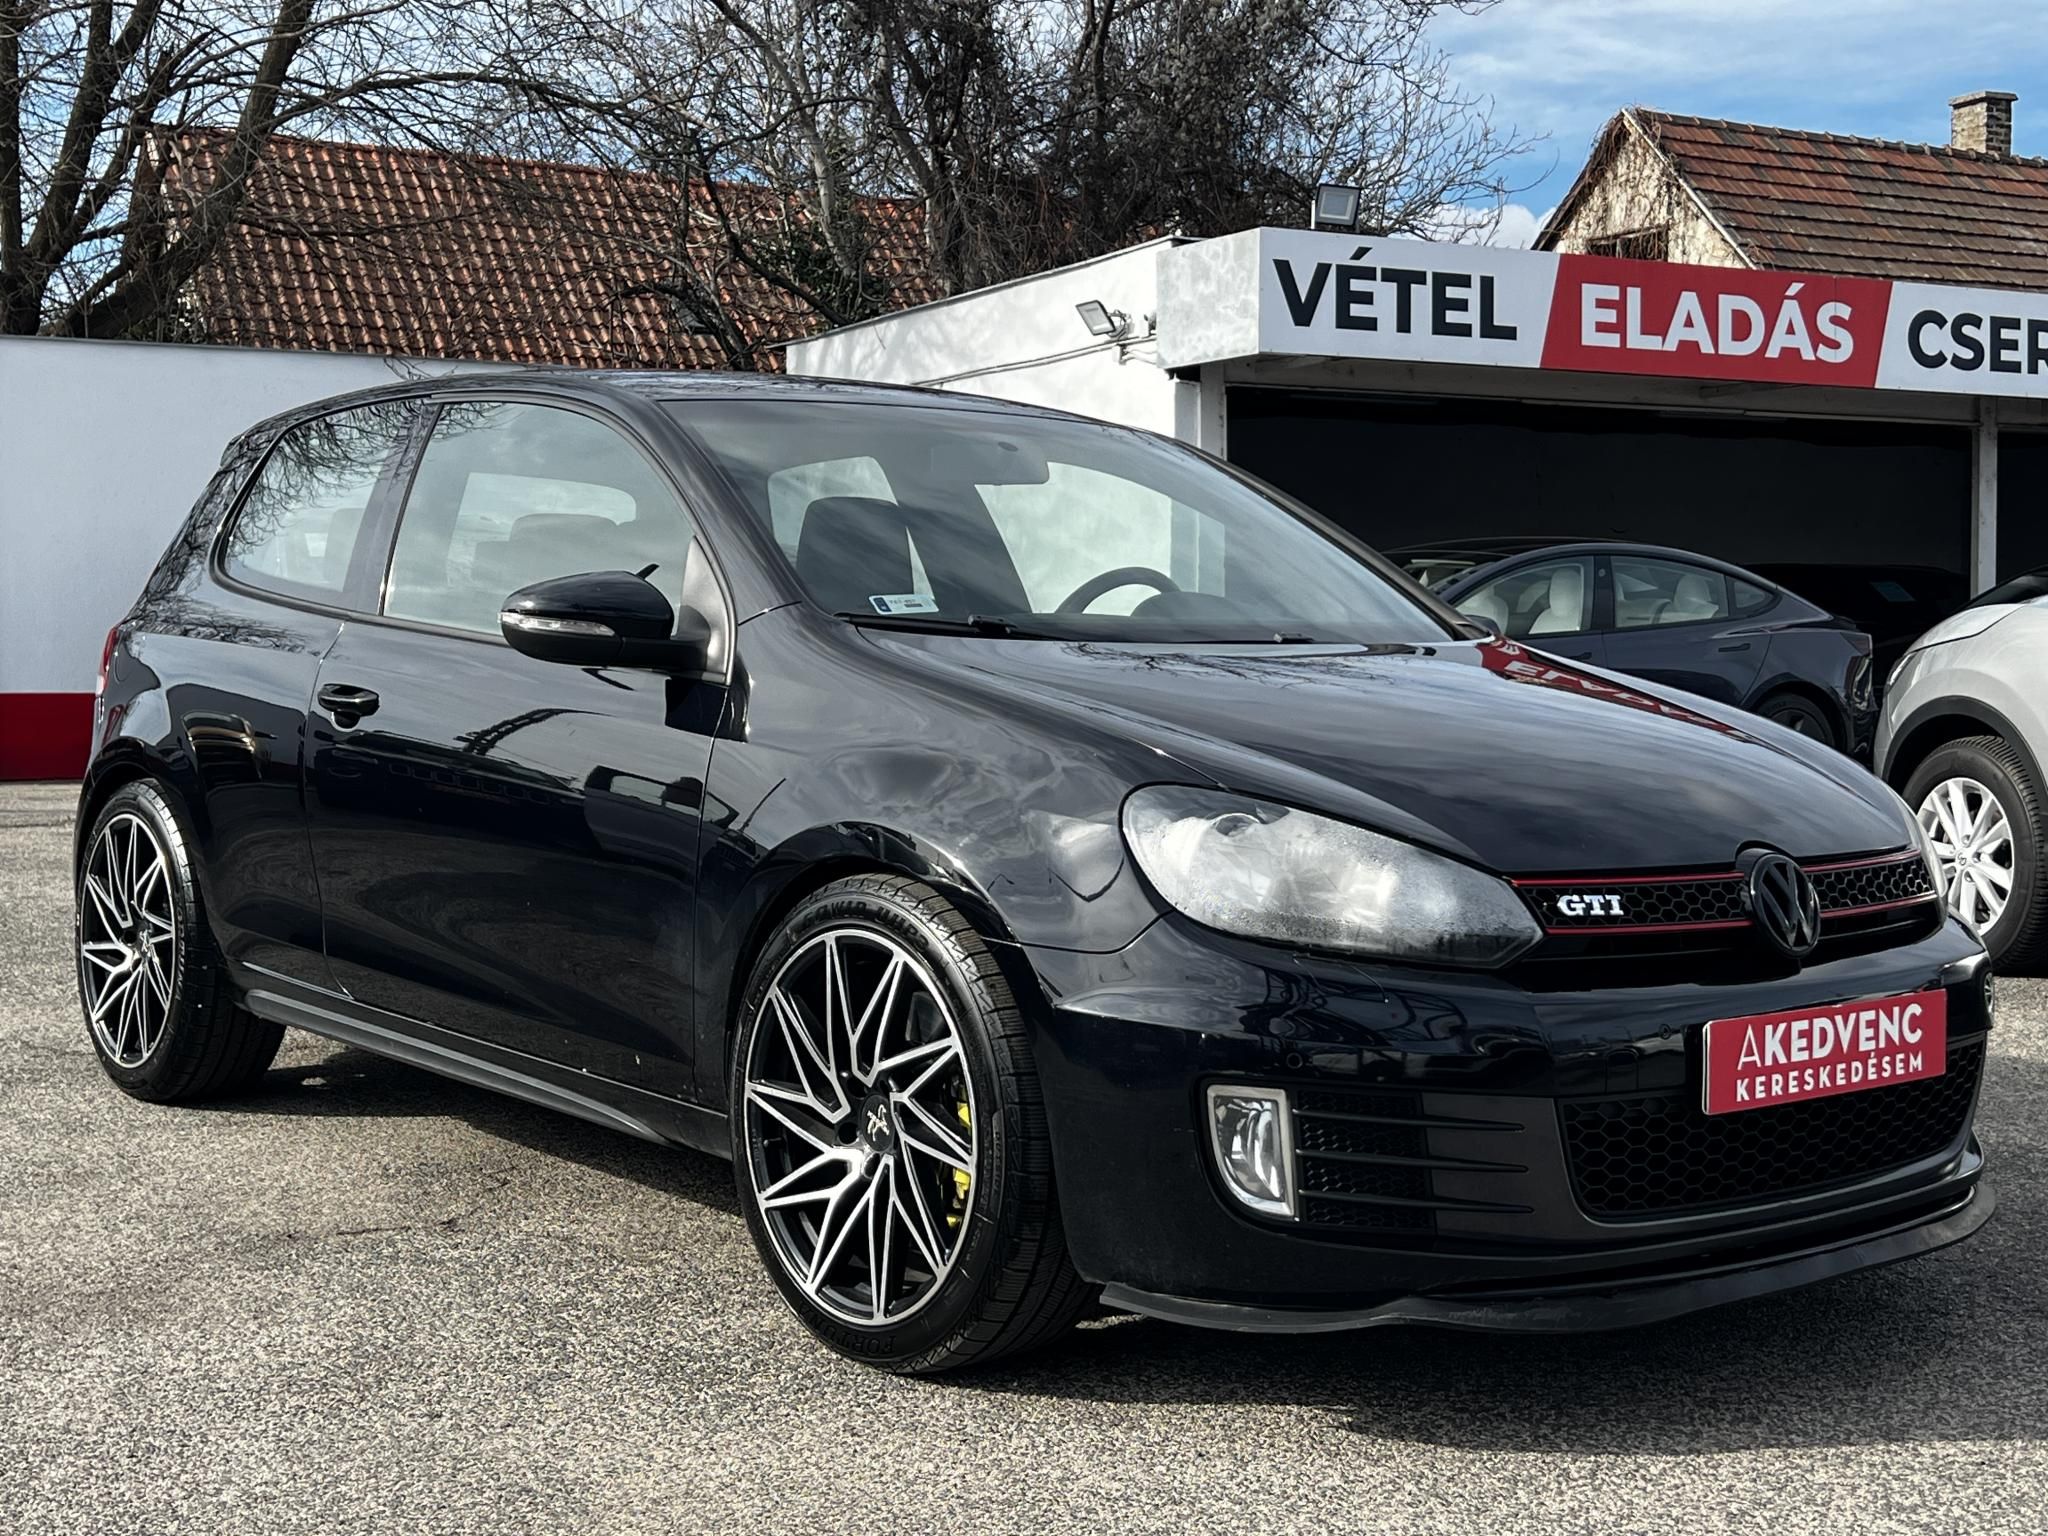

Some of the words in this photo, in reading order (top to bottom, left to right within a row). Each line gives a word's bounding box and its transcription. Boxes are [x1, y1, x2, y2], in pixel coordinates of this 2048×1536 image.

[1272, 246, 1518, 341] VÉTEL
[1580, 282, 1854, 364] ELADÁS
[1557, 894, 1624, 916] GTI
[1737, 1003, 1923, 1070] AKEDVENC
[1736, 1050, 1923, 1102] KERESKEDÉSEM
